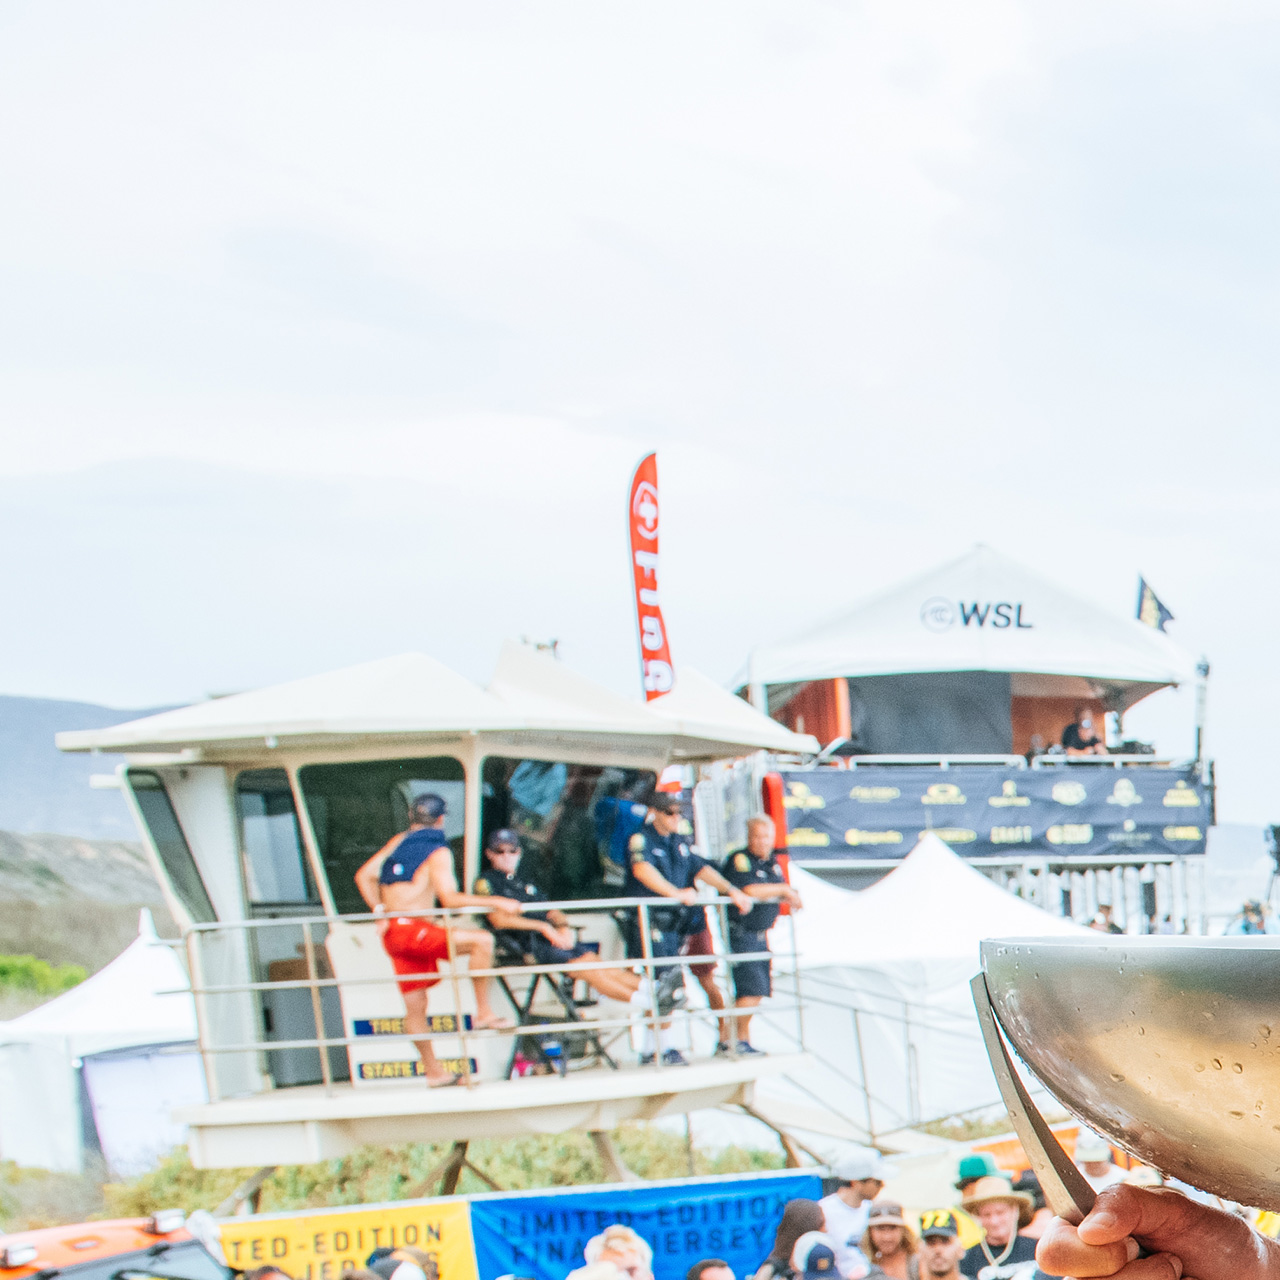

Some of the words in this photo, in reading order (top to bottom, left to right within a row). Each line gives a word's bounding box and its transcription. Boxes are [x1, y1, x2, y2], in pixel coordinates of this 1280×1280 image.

[959, 601, 1034, 629] WSL
[362, 1063, 412, 1079] STATE
[231, 1223, 442, 1262] TED-EDITION
